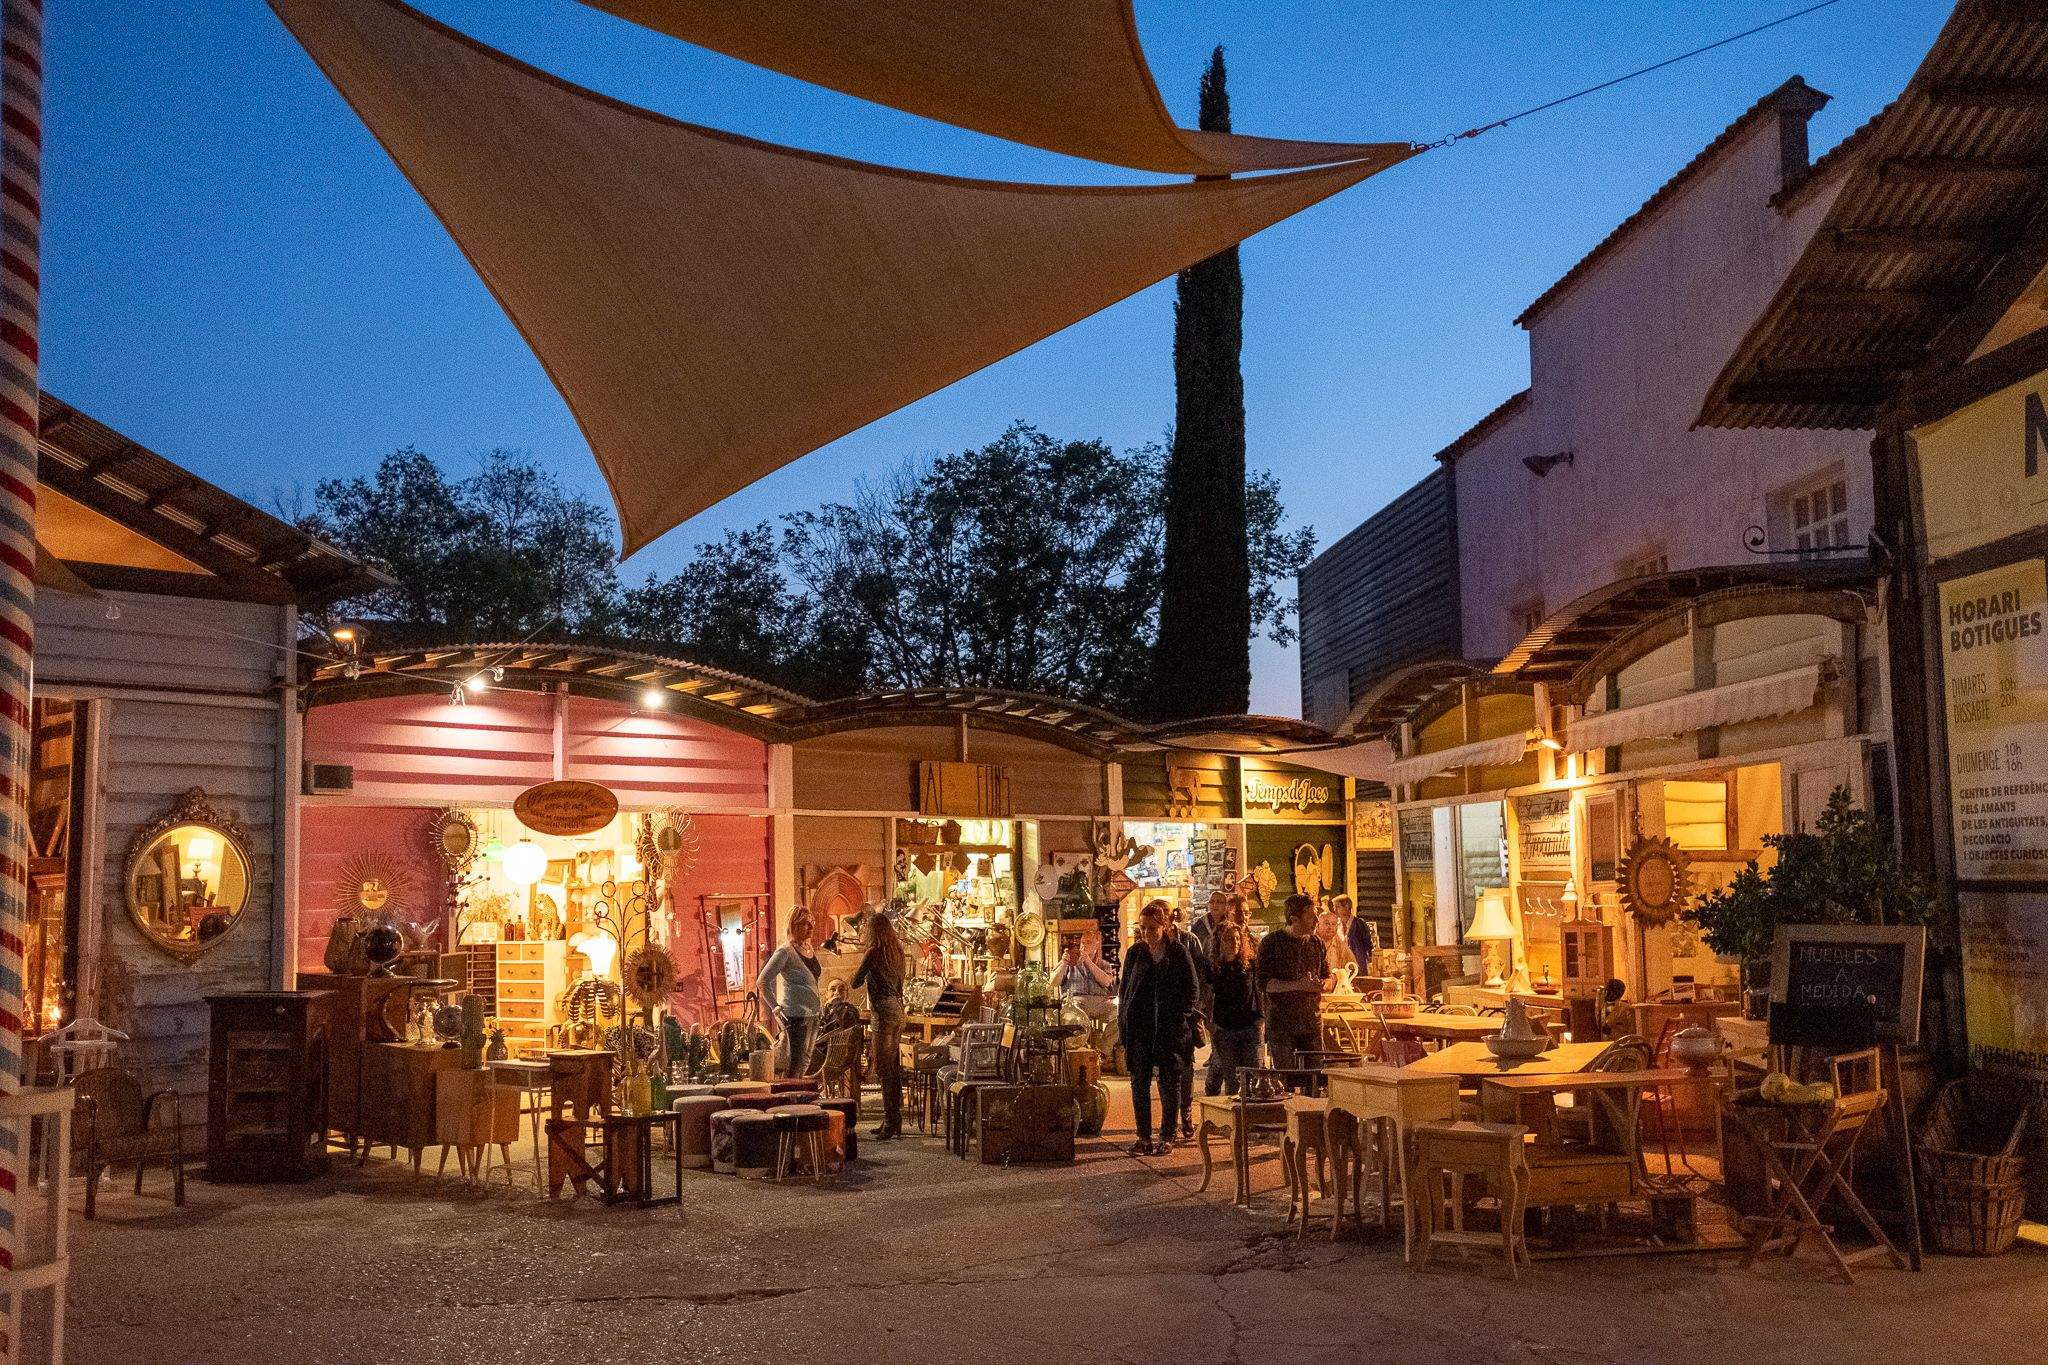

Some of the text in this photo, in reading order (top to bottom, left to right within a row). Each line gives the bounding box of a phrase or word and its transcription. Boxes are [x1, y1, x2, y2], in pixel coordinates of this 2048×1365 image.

[1950, 588, 2020, 626] HORARI
[1951, 611, 2042, 652] BOTIGUES
[1951, 673, 1987, 698] DIMARTS
[2000, 676, 2016, 692] 10h
[2000, 693, 2018, 708] 20h
[1953, 699, 1990, 724] DISSABTE
[2005, 742, 2022, 757] 10h
[1956, 749, 2000, 774] DIUMENGE
[1960, 787, 1989, 800] CENTRE
[1991, 786, 2002, 797] DE
[1960, 801, 2016, 815] PELS AMANTS
[1962, 819, 1972, 830] DE
[1974, 819, 1987, 830] LES
[1963, 831, 2012, 846] DECORACIÓ
[1968, 848, 2009, 861] OBJECTES
[1799, 946, 1878, 966] MUEBLES
[1835, 968, 1849, 982] A
[1800, 983, 1866, 1000] MEDIDA
